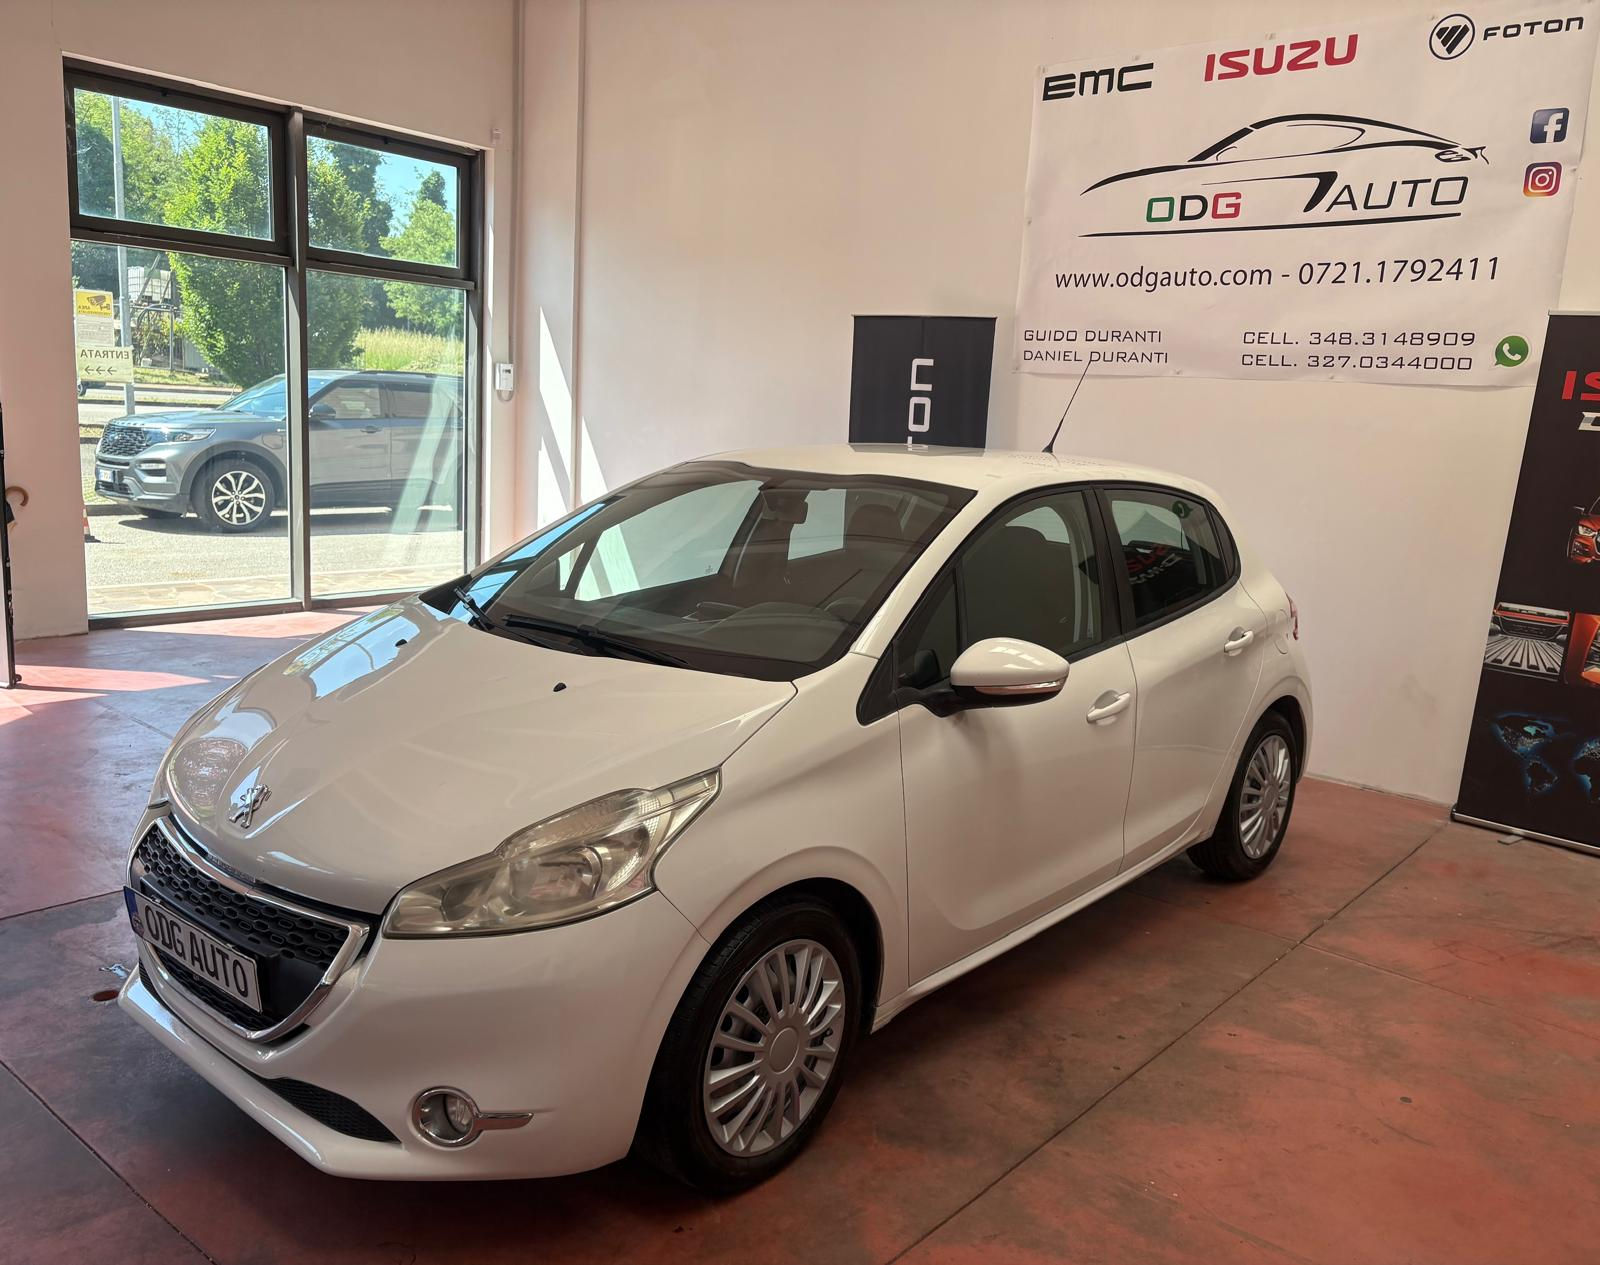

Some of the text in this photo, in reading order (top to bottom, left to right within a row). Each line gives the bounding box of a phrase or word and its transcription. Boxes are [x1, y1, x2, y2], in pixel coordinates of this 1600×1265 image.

[1204, 33, 1359, 82] ISUZU
[1042, 62, 1154, 102] EMC
[1146, 191, 1242, 223] ODG
[1055, 265, 1273, 293] www.odgauto.com
[1298, 256, 1499, 285] 0721.1792411
[1024, 330, 1162, 343] GUIDO DURANTI
[1243, 331, 1476, 347] CELL. 348.3148909
[1023, 350, 1168, 364] DANIEL DURANTI
[1241, 353, 1473, 370] CELL. 327.0344000
[144, 904, 249, 998] ODG AUTO
